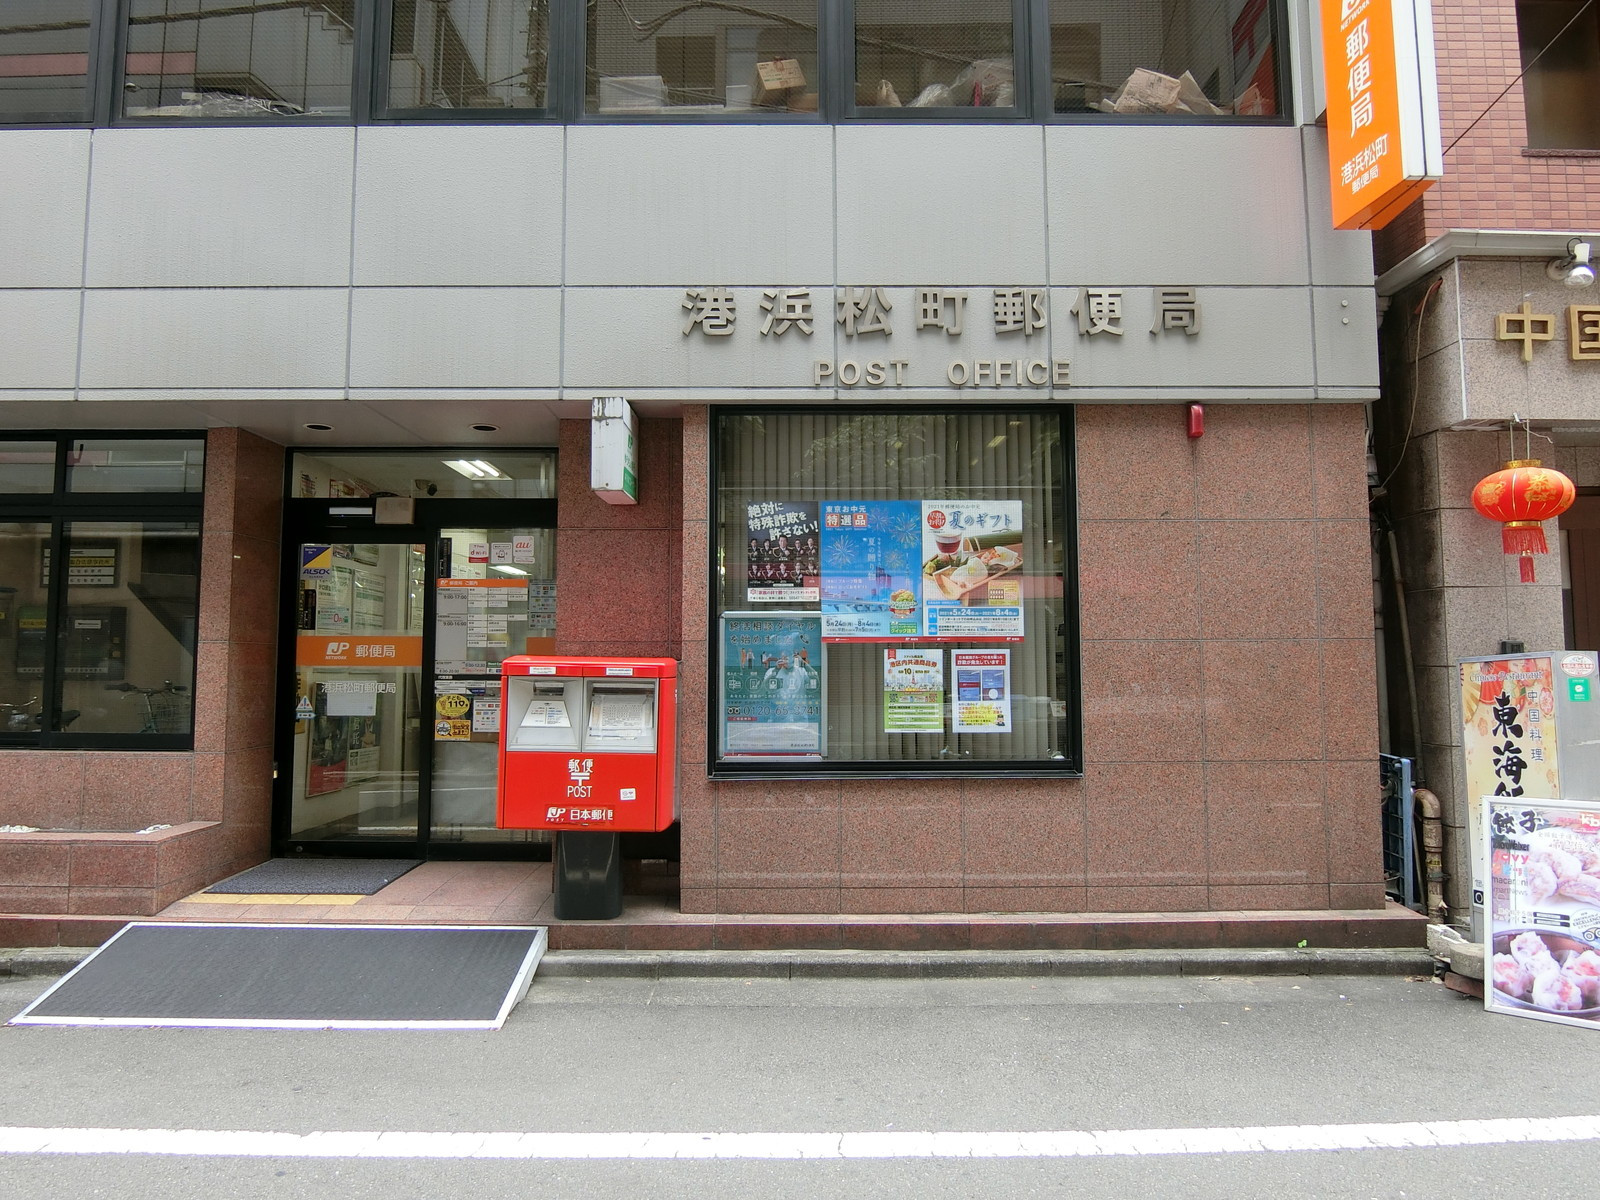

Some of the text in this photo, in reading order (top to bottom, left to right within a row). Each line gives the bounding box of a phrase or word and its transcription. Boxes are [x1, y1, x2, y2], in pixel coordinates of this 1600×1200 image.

[1340, 0, 1370, 32] NETWORK
[1346, 18, 1373, 138] 郵便局
[1341, 134, 1388, 186] 港浜松町
[1352, 165, 1379, 194] 郵便局
[682, 286, 1201, 337] 港浜松町郵便局
[814, 360, 1072, 387] POST OFFICE
[747, 501, 784, 518] 絶対に
[826, 505, 866, 513] 東京お中元
[748, 511, 807, 532] 特殊詐欺を
[949, 510, 1013, 530] 夏のギフト
[515, 541, 532, 549] au
[730, 634, 794, 645] を始めました
[326, 642, 350, 655] JP
[355, 645, 396, 658] 郵便局
[321, 682, 397, 693] 港浜松町郵便局
[568, 759, 594, 773] 郵便
[567, 785, 593, 798] POST
[547, 807, 566, 818] JP
[570, 809, 614, 821] 日本郵便
[1492, 809, 1542, 835] 餃子
